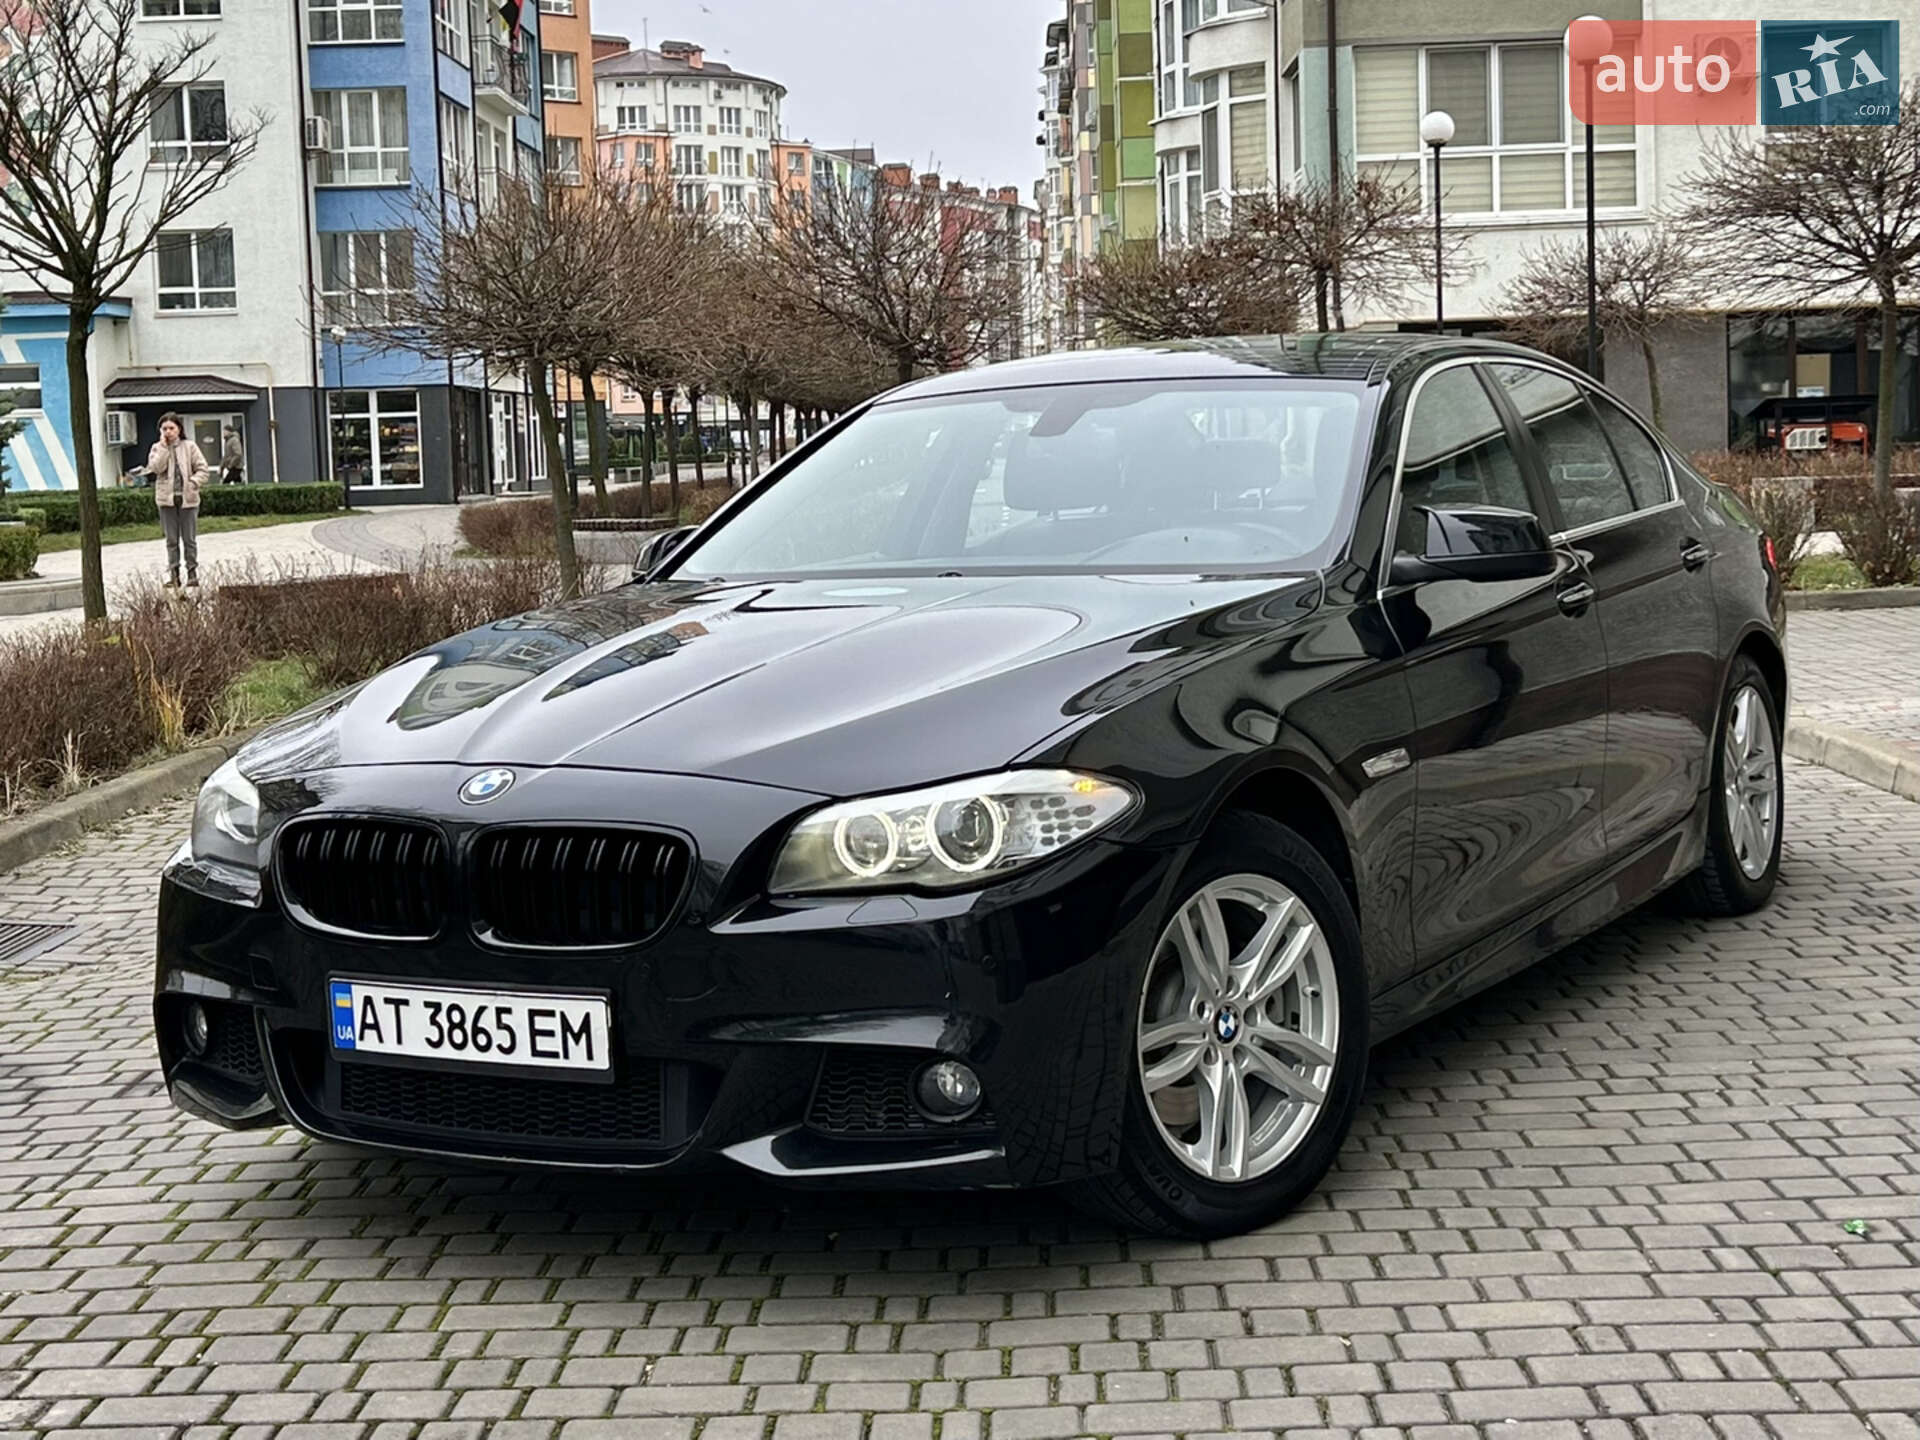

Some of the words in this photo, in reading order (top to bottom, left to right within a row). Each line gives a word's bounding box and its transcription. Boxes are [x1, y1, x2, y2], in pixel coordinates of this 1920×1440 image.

[337, 1025, 355, 1041] UA
[358, 995, 410, 1046] AT
[423, 1001, 517, 1055] 3865
[527, 1008, 595, 1061] EM
